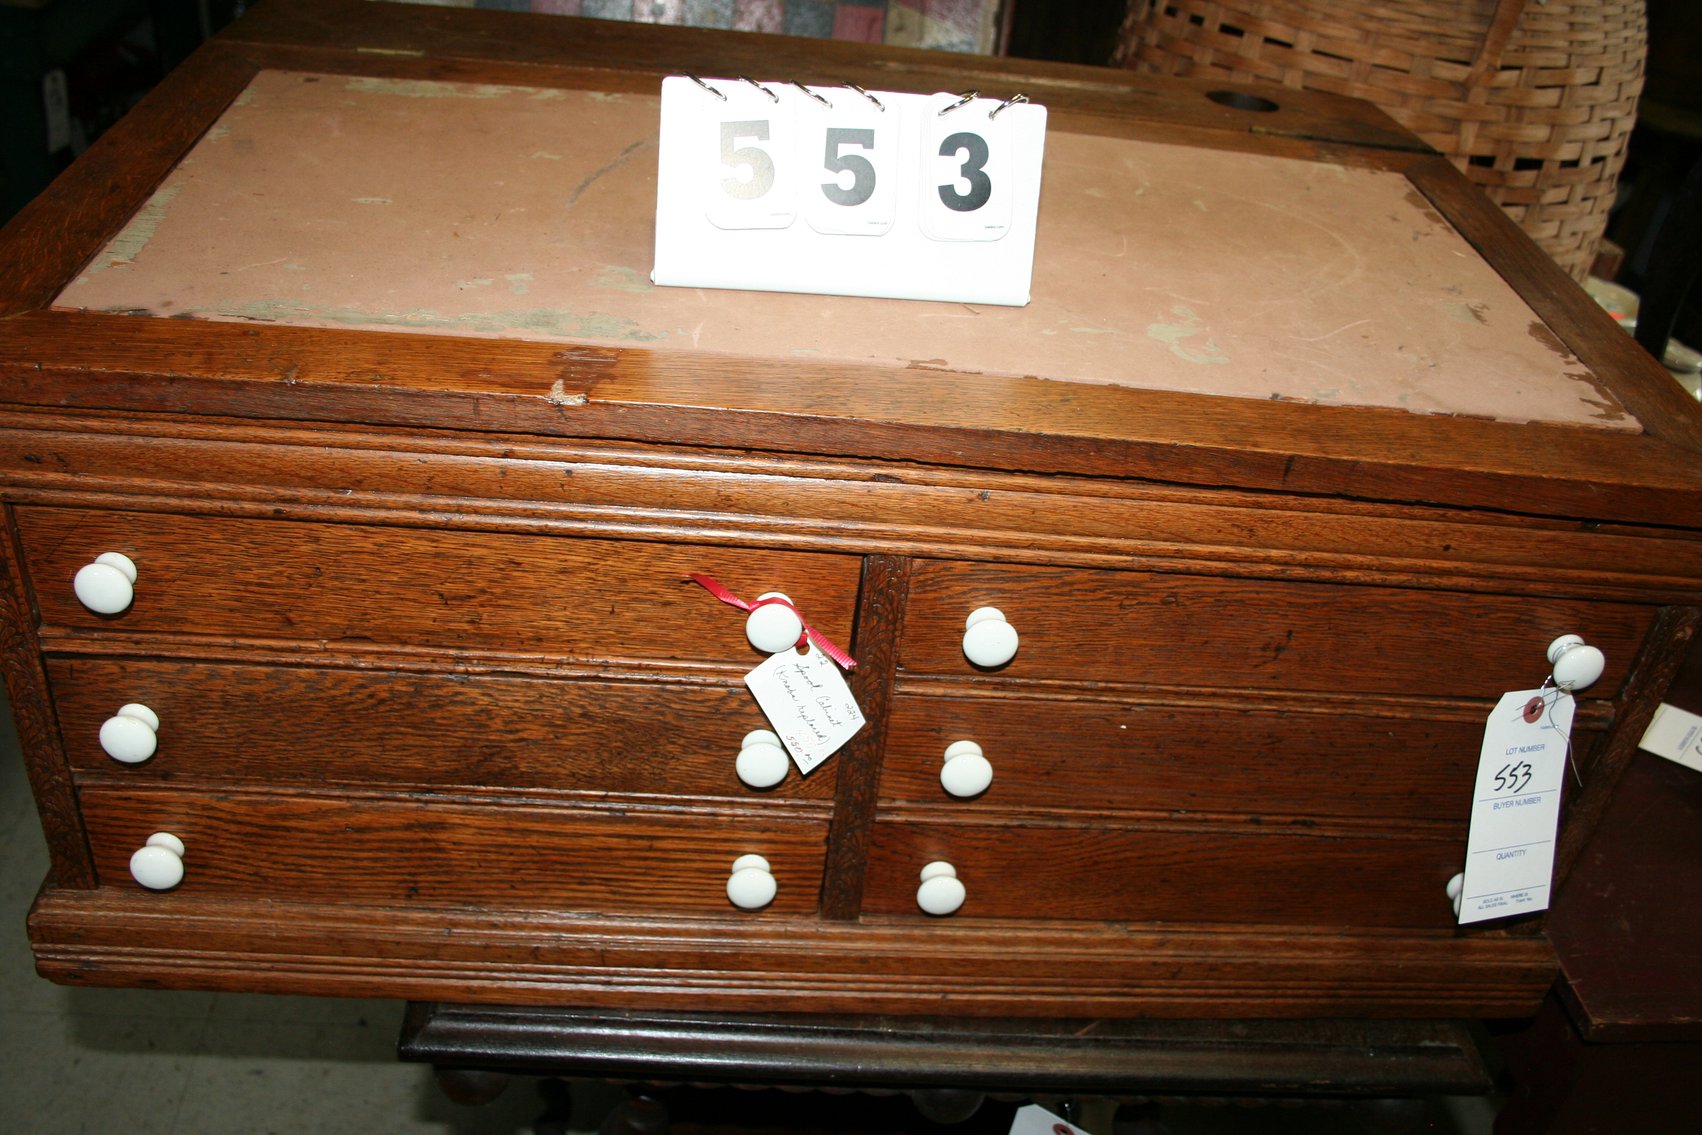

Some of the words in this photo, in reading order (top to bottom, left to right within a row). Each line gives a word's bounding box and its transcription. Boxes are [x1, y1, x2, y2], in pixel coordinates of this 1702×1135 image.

[1506, 746, 1519, 755] LOT
[1519, 744, 1545, 753] NUMBER
[1493, 760, 1533, 794] 553
[1492, 799, 1514, 811] BUYER
[1515, 796, 1542, 808] NUMBER
[1496, 849, 1527, 860] QUANTITY
